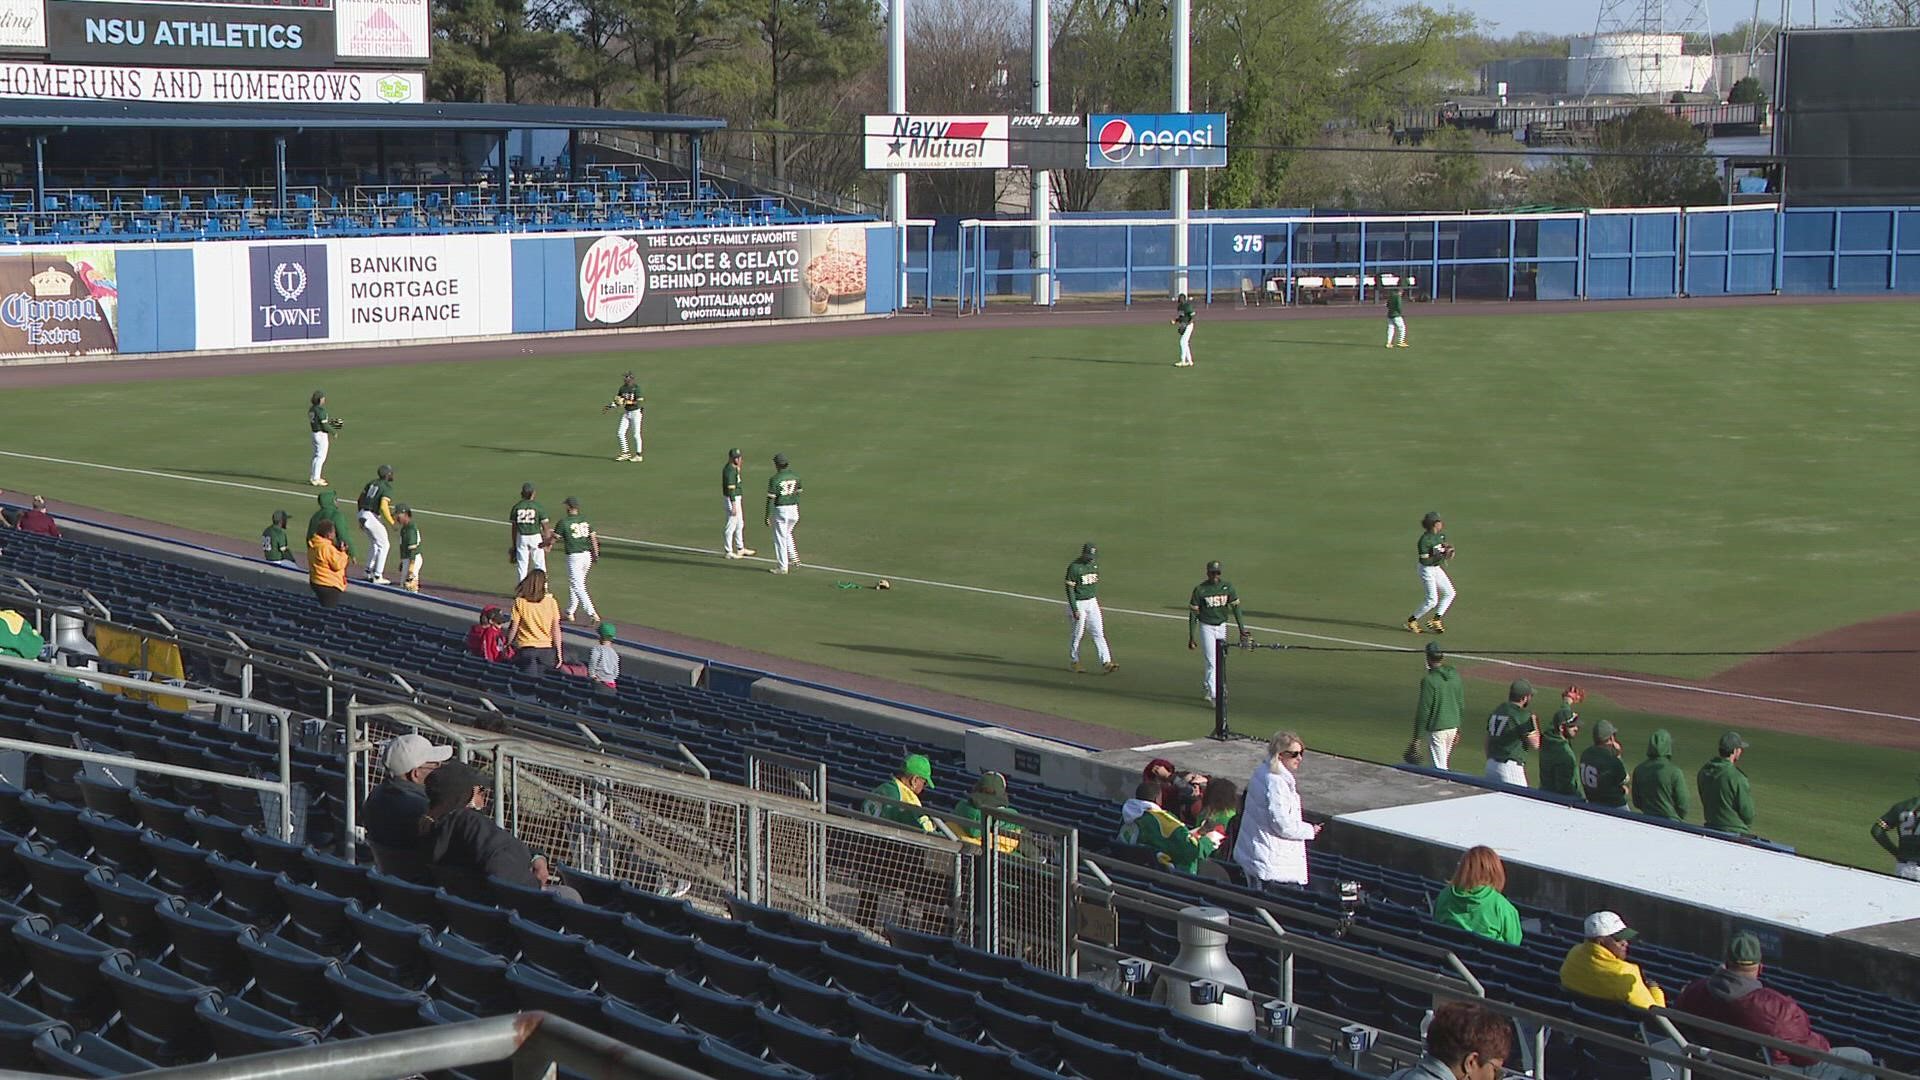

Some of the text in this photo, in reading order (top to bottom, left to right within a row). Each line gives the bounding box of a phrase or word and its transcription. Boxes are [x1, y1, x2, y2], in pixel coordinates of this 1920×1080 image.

[85, 18, 303, 49] NSU ATHLETICS
[0, 66, 142, 98] HOMERUNS
[152, 70, 202, 99] AND
[213, 72, 361, 101] HOMEGROWS
[893, 116, 950, 140] Navy
[1011, 116, 1080, 129] PITCH SPEED
[908, 137, 985, 159] Mutual
[1139, 124, 1213, 157] pepsi
[647, 236, 668, 247] THE
[714, 233, 749, 245] FAMILY
[751, 231, 797, 244] FAVORITE
[1233, 234, 1263, 253] 375
[351, 255, 437, 274] BANKING
[648, 254, 665, 264] GET
[648, 264, 666, 272] YOUR
[666, 249, 799, 272] SLICE & GELATO
[600, 281, 634, 295] Italian
[649, 268, 799, 289] BEHIND HOME PLATE
[351, 279, 459, 299] MORTGAGE
[1, 291, 101, 330] Corona
[674, 292, 774, 309] YNOTITALIAN.COM
[260, 303, 321, 328] TOWNE
[352, 303, 461, 324] INSURANCE
[681, 308, 740, 320] @YNOTITALIAN
[28, 322, 82, 345] Extra
[779, 479, 797, 496] 37
[516, 508, 536, 524] 22
[1900, 810, 1920, 836] 2
